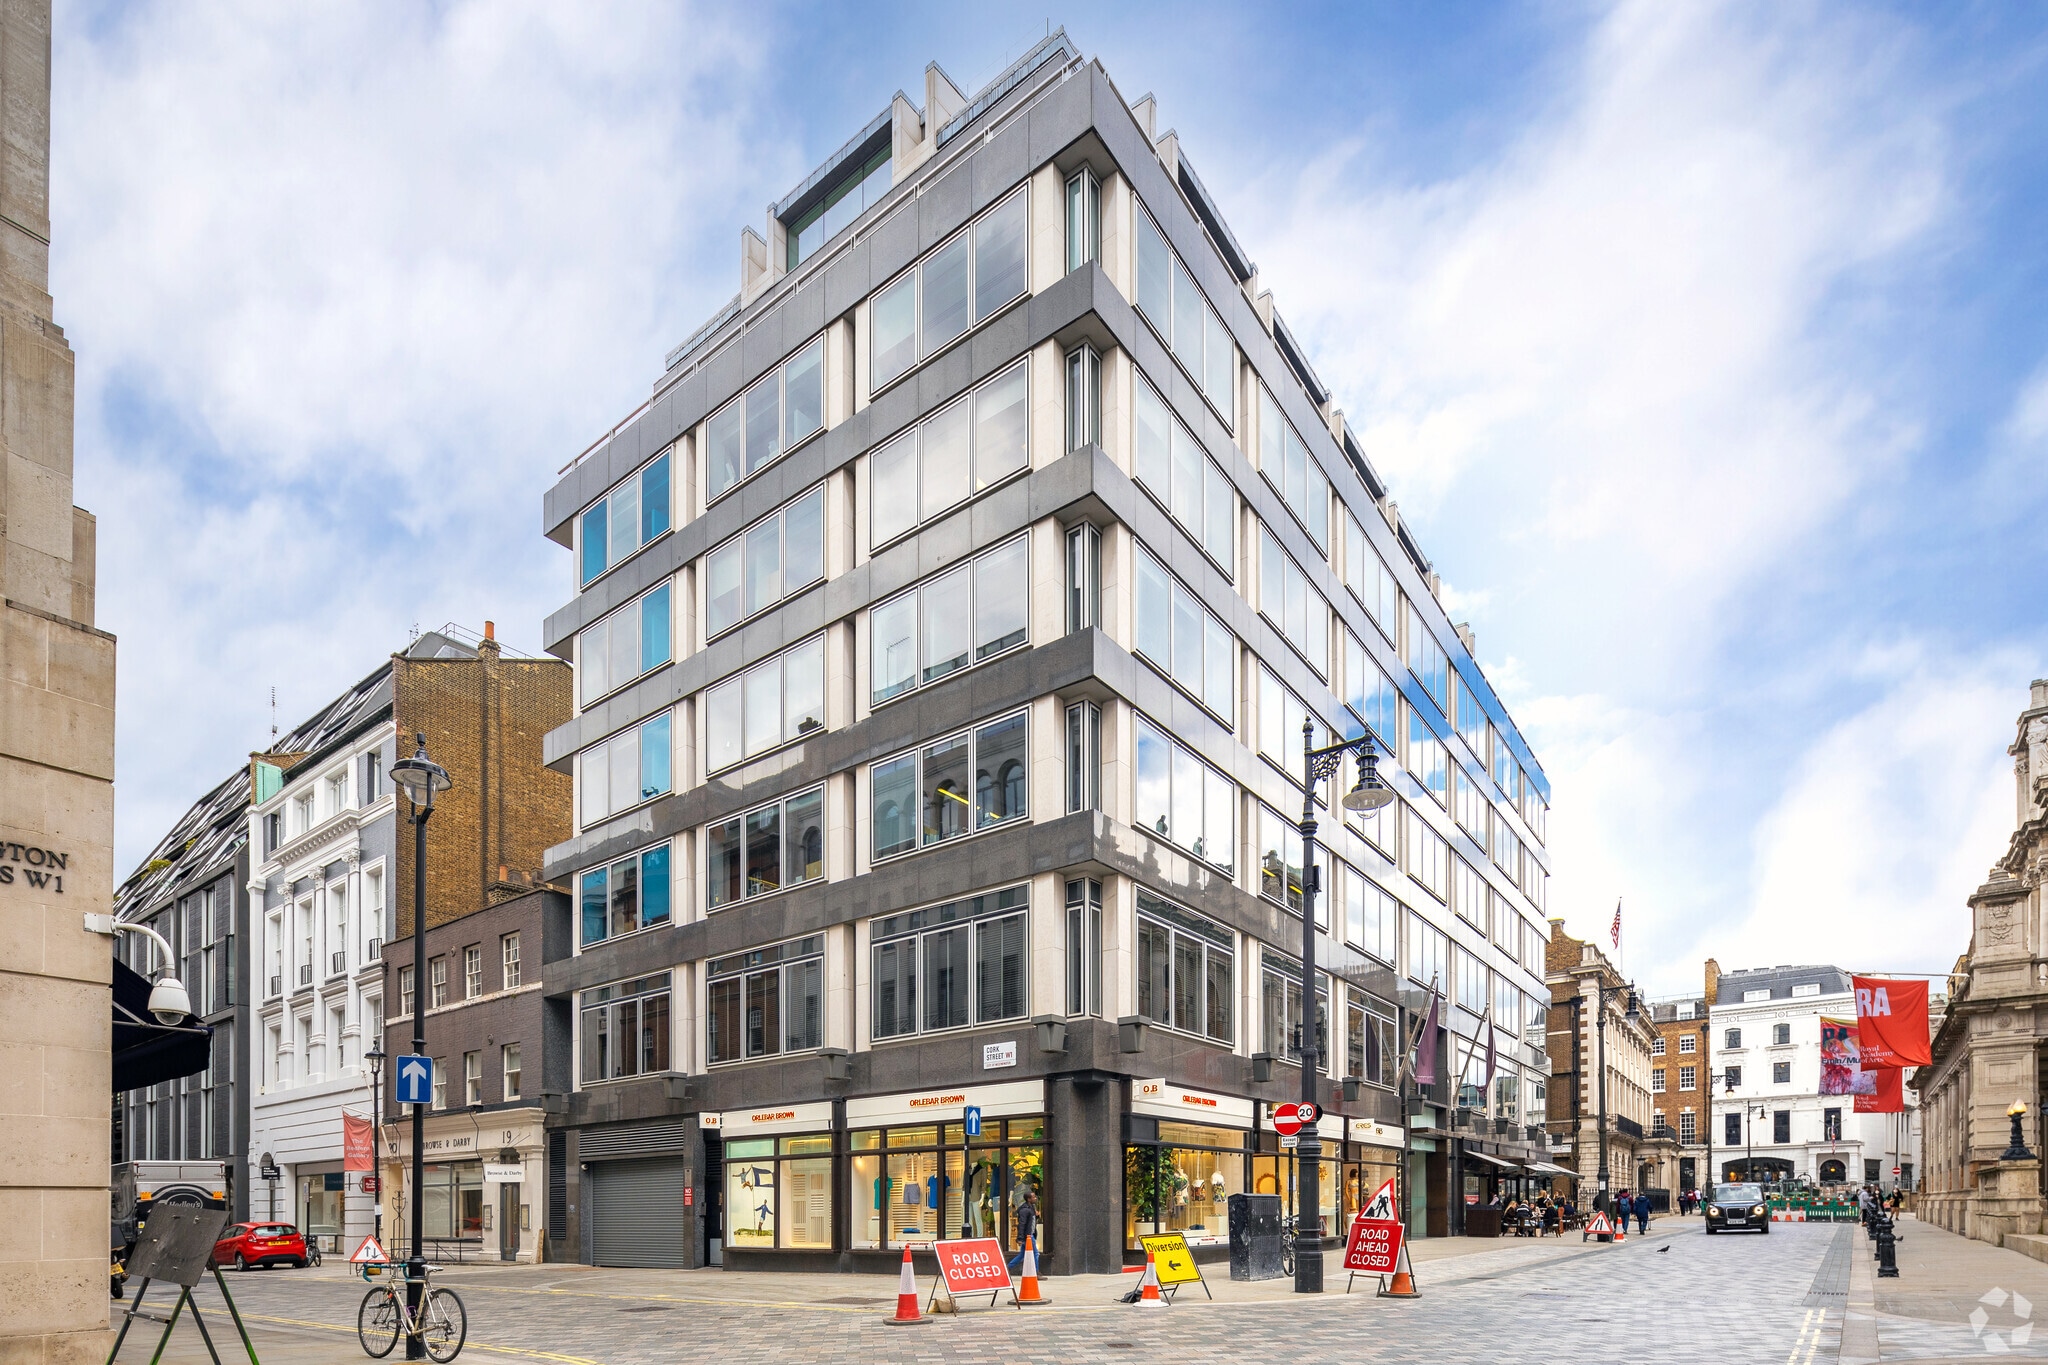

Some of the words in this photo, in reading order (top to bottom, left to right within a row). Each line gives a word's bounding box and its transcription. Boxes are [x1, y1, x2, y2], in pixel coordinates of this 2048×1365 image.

[23, 869, 64, 893] W1
[1856, 987, 1891, 1017] RA
[1860, 1045, 1879, 1053] Royal
[986, 1053, 1004, 1061] STREET
[909, 1098, 939, 1107] ORLEBAR
[940, 1094, 965, 1104] BROWN
[752, 1114, 775, 1122] ORLEBAR
[776, 1112, 794, 1120] BROWN
[1299, 1107, 1313, 1117] 20
[453, 1137, 471, 1147] DARBY
[502, 1130, 512, 1144] 19
[1360, 1228, 1389, 1240] ROAD
[1146, 1240, 1186, 1253] Diversion
[1355, 1241, 1389, 1254] AHEAD
[952, 1251, 989, 1266] ROAD
[1350, 1253, 1390, 1267] CLOSED
[949, 1265, 1001, 1280] CLOSED
